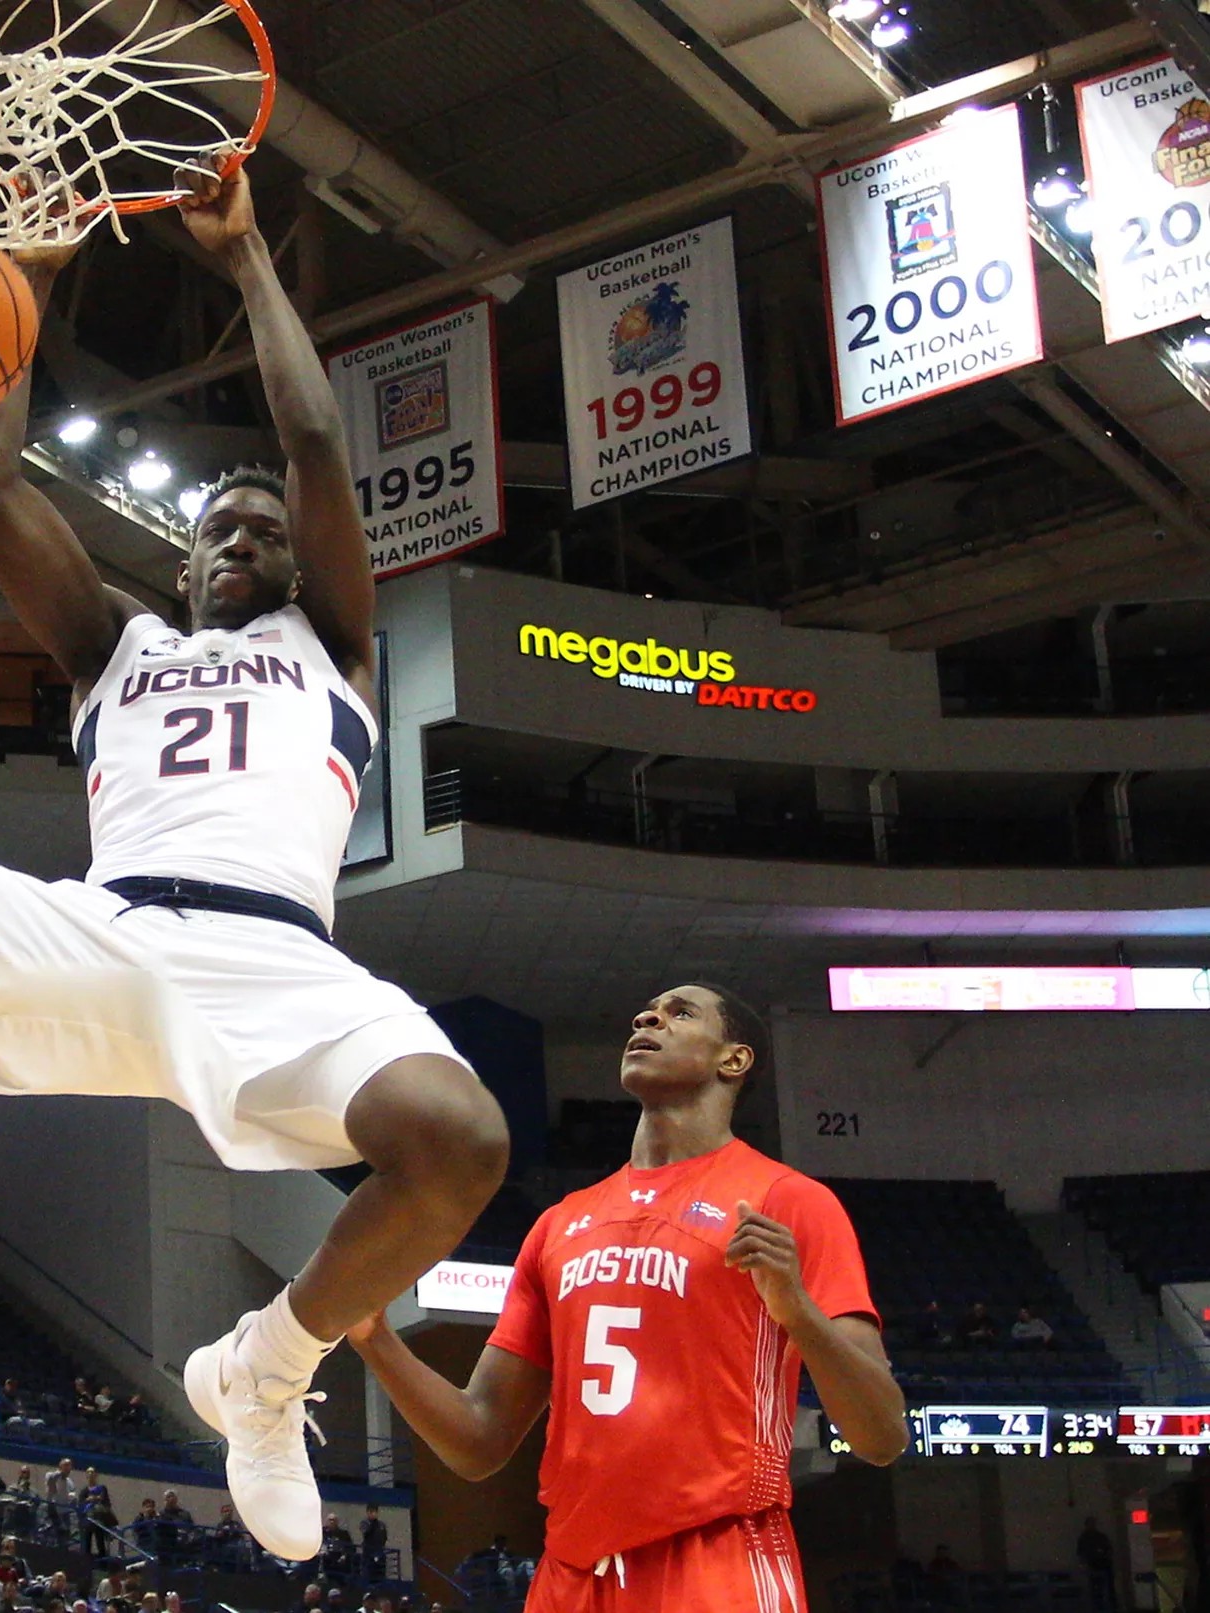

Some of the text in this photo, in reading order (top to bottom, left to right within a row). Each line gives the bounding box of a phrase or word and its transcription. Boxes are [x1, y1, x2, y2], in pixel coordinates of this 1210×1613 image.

[1100, 66, 1168, 97] UConn
[837, 158, 899, 187] UConn
[587, 232, 701, 281] UConn Men's
[1120, 201, 1210, 266] 20
[600, 255, 691, 298] Basketball
[846, 260, 1013, 352] 2000
[342, 311, 475, 368] UConn Women's
[367, 338, 451, 380] Basketball
[870, 319, 1000, 375] NATIONAL
[862, 341, 1014, 405] CHAMPIONS
[587, 361, 721, 440] 1999
[591, 437, 731, 497] CHAMPIONS
[598, 415, 720, 468] NATIONAL
[355, 440, 475, 518] 1995
[370, 516, 483, 569] HAMPIONS
[519, 624, 735, 682] megabus
[119, 654, 306, 707] UCONN
[619, 673, 817, 713] DRIVEN BY DATTCO
[159, 701, 249, 777] 21
[816, 1112, 860, 1137] 221
[437, 1271, 505, 1289] RICOH
[558, 1246, 689, 1301] BOSTON
[581, 1304, 641, 1416] 5
[997, 1413, 1030, 1436] 74
[1063, 1413, 1113, 1437] 3:34
[1067, 1441, 1094, 1455] 2ND
[1133, 1414, 1163, 1436] 57
